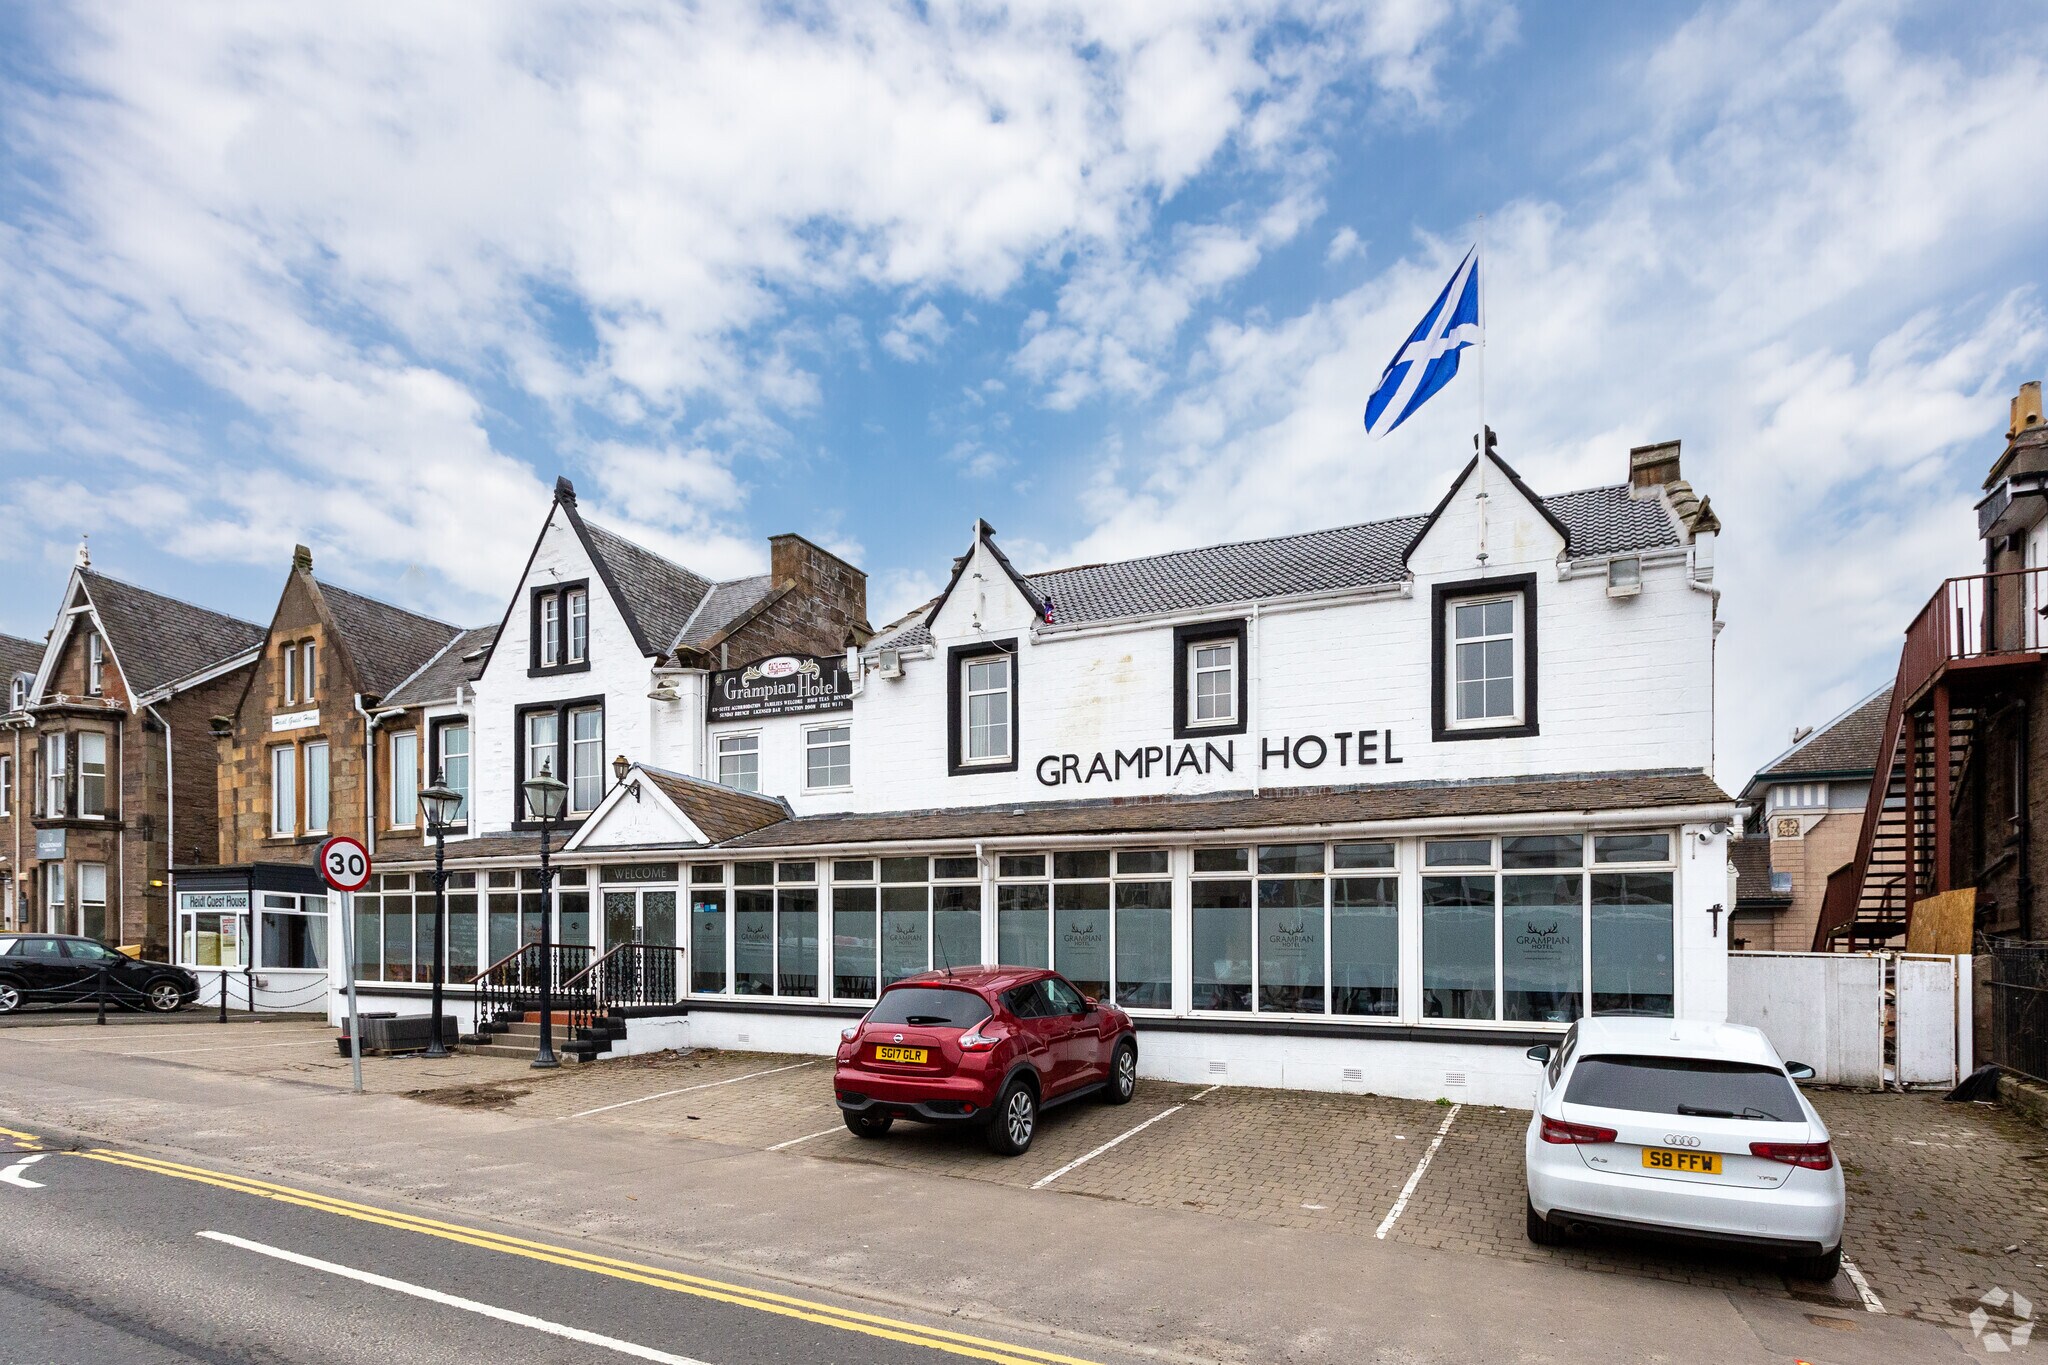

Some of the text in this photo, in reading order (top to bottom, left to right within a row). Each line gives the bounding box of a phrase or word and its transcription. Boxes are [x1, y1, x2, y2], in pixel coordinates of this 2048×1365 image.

[723, 669, 839, 701] Grampian Hotel
[764, 700, 783, 708] FAMILIES
[1036, 729, 1404, 787] GRAMPIAN HOTEL
[328, 852, 365, 877] 30
[614, 866, 667, 880] WELCOME
[206, 895, 225, 908] Guest
[226, 895, 247, 908] House
[889, 934, 922, 942] GRAMPIAN
[1063, 934, 1102, 943] GRAMPIAN
[1269, 934, 1314, 943] GRAMPIAN
[1516, 935, 1570, 945] GRAMPIAN
[881, 1047, 922, 1061] SG17 GLR
[1650, 1151, 1713, 1172] S8 FFW
